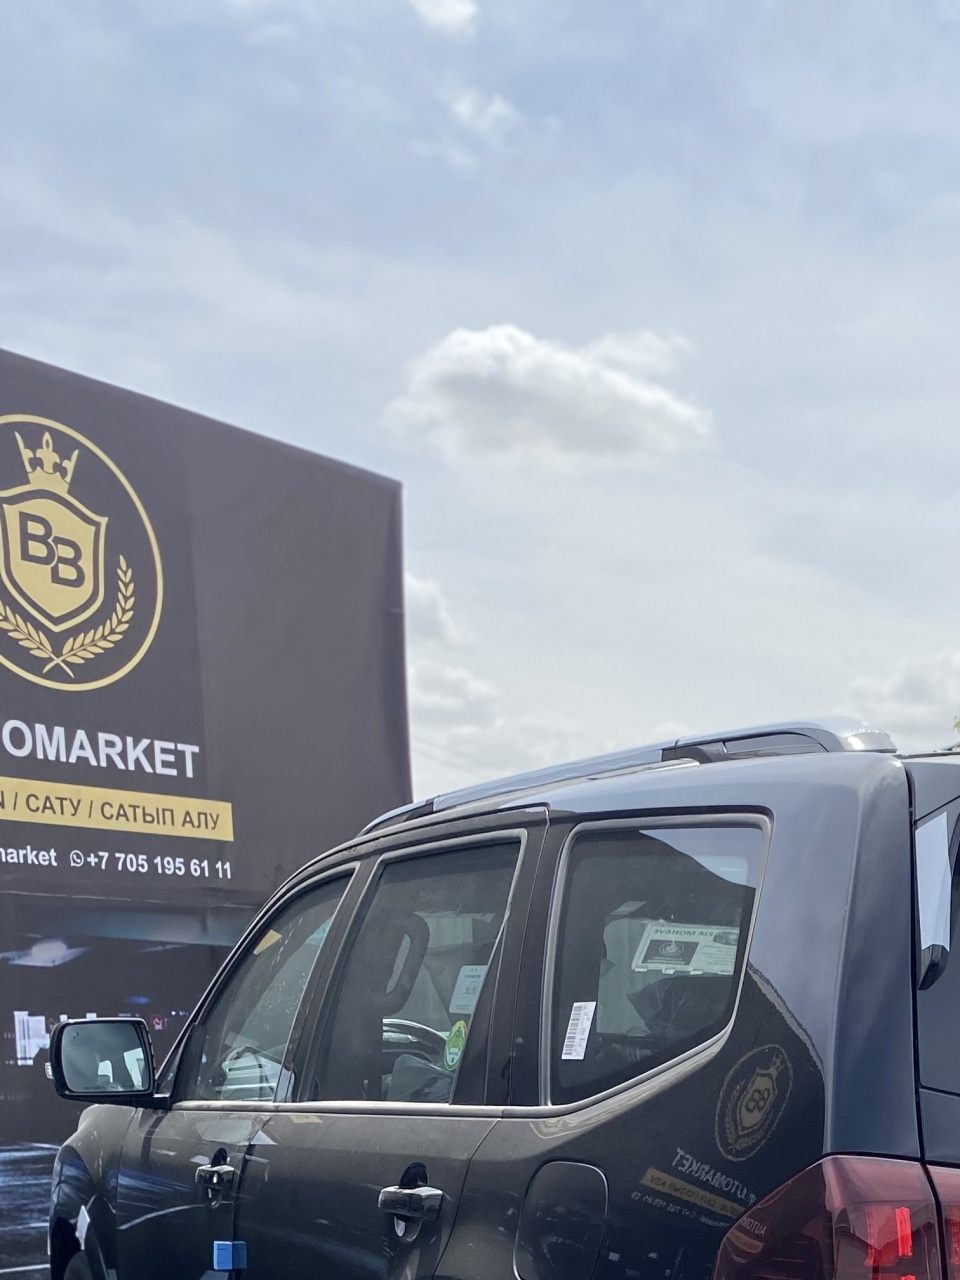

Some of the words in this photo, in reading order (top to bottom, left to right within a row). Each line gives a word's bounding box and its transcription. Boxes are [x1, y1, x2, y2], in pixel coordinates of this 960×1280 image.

[1, 719, 200, 778] OMARKET
[25, 793, 82, 816] САТУ
[100, 801, 175, 826] САТЫП
[181, 810, 220, 830] АЛУ
[86, 852, 109, 870] +7
[114, 853, 148, 873] 705
[154, 855, 185, 876] 195
[190, 859, 209, 877] 61
[215, 861, 232, 879] 11
